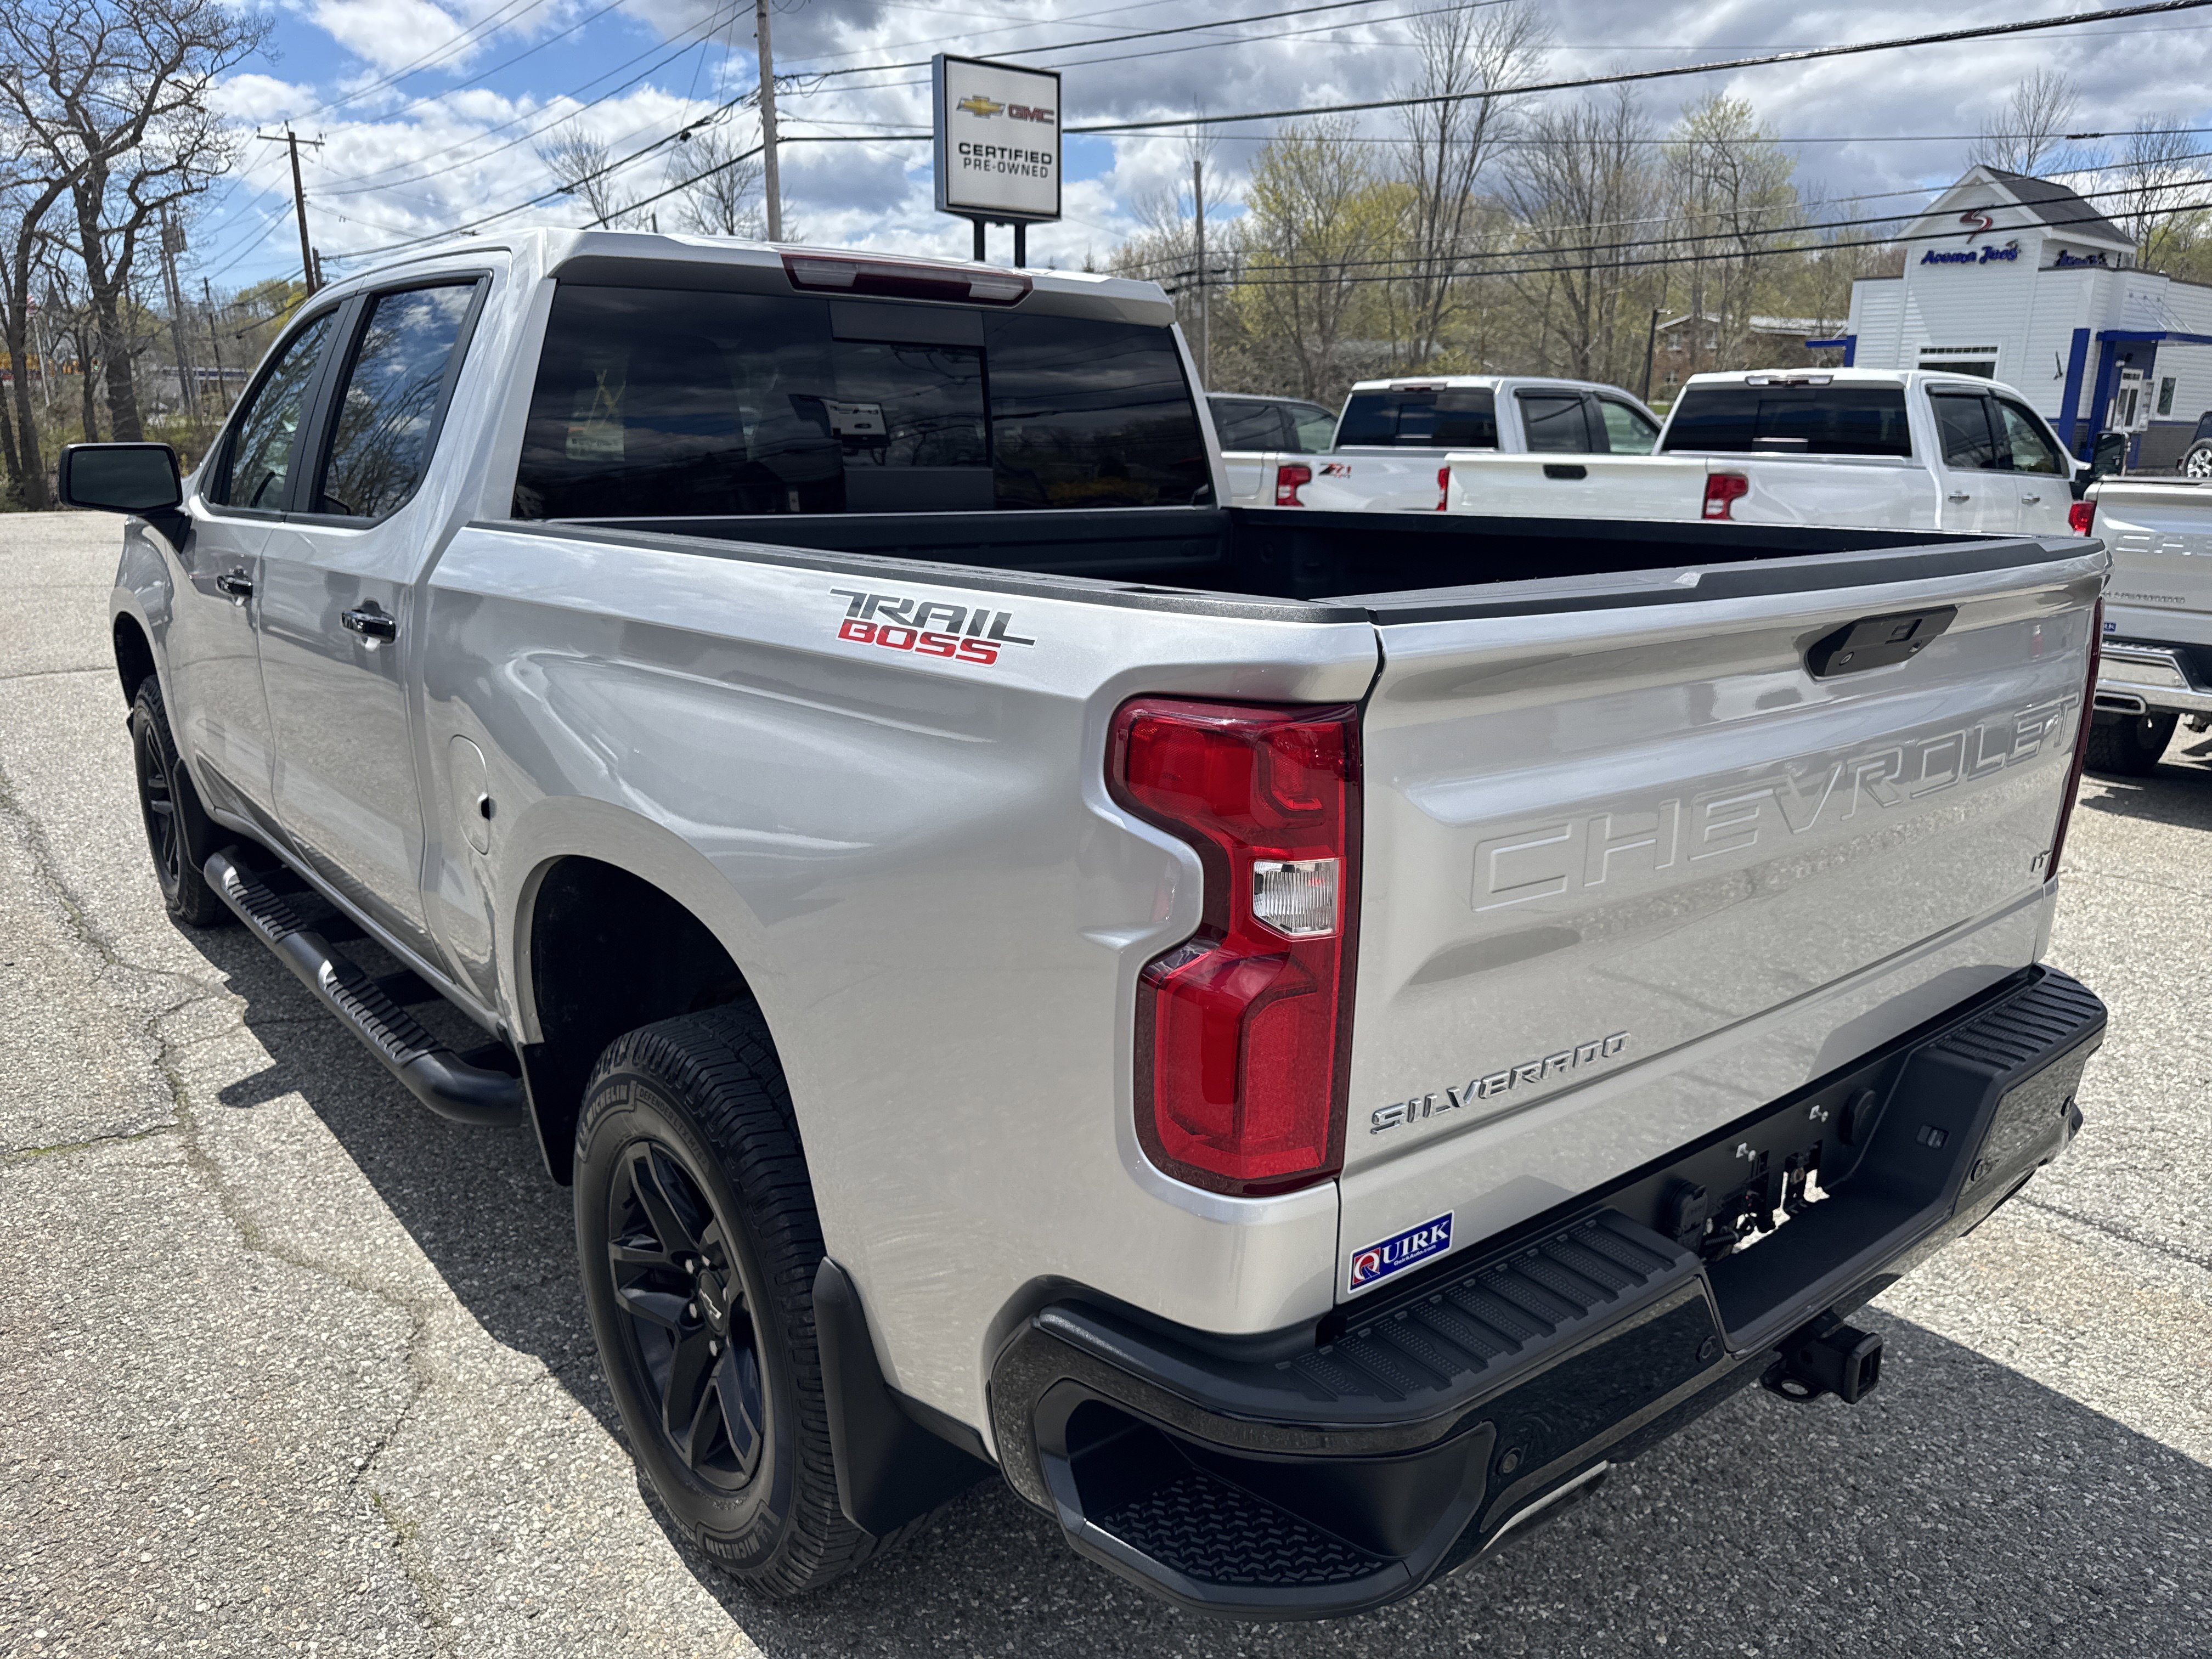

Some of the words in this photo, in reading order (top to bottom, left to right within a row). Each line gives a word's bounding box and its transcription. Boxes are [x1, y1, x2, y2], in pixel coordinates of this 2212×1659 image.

[1008, 104, 1054, 125] GMC
[958, 143, 1052, 165] CERTIFIED
[963, 157, 1048, 178] PRE-OWNED
[829, 588, 1036, 646] TRAIL
[837, 618, 1001, 665] BOSS
[1471, 691, 2080, 912] CHEVROLET
[2030, 850, 2051, 873] LT
[1370, 1030, 1632, 1135] SILVERADO
[586, 1084, 628, 1128] MICHELIN
[640, 1088, 675, 1119] DEFENDER
[673, 1115, 689, 1137] LTX
[1354, 1220, 1449, 1280] QUIRK
[1393, 1244, 1436, 1266] QuirkAuto.com
[705, 1533, 761, 1560] MICHELIN
